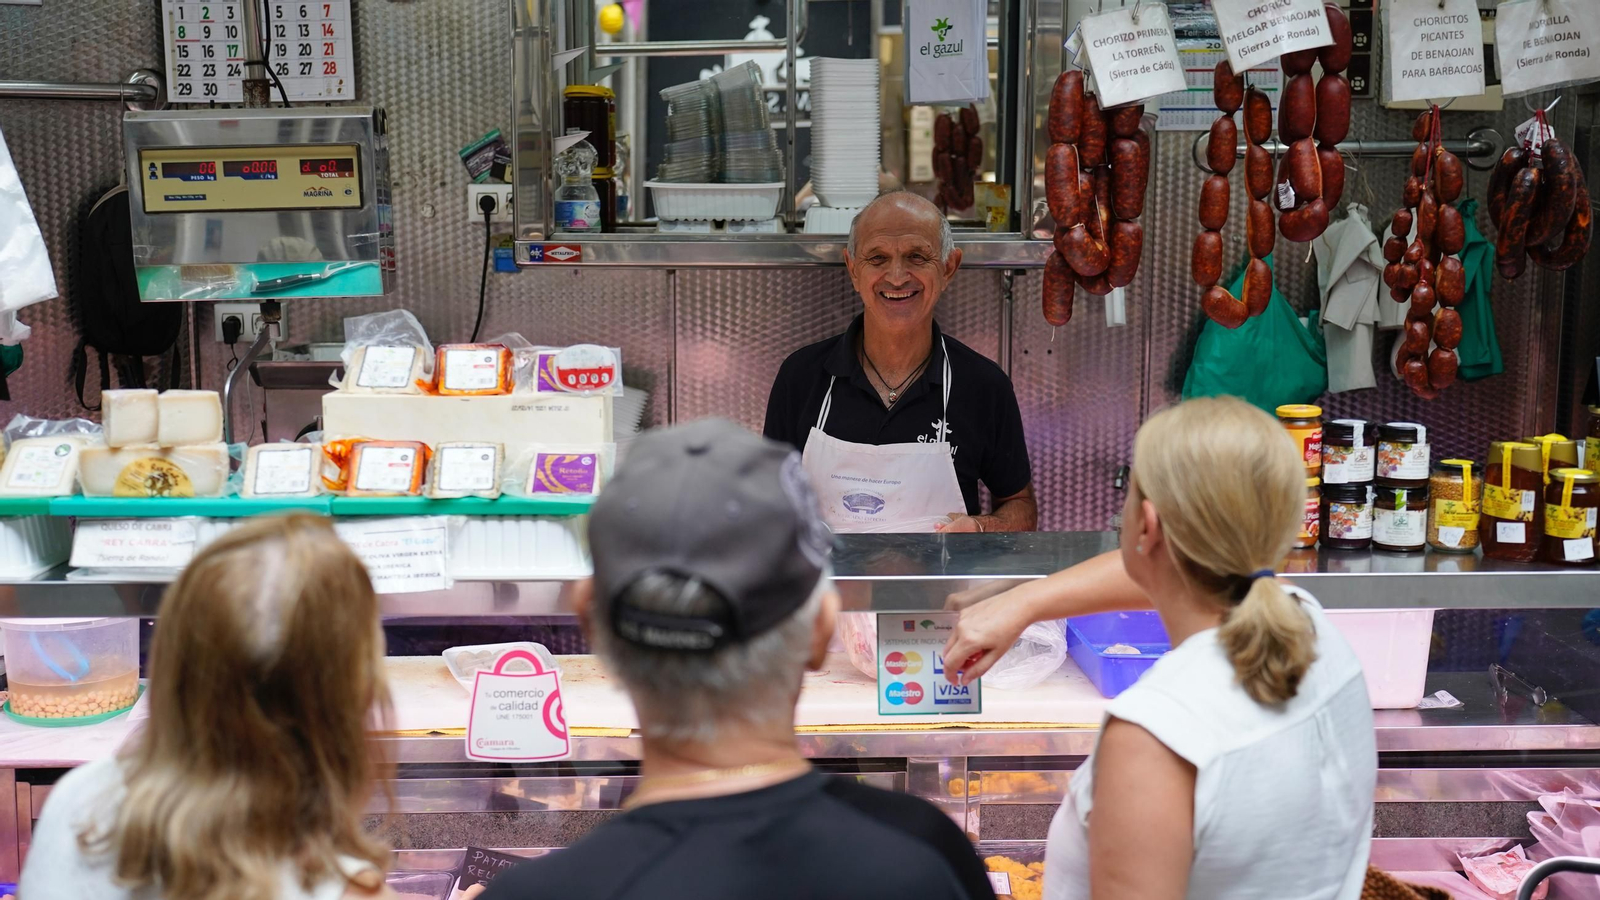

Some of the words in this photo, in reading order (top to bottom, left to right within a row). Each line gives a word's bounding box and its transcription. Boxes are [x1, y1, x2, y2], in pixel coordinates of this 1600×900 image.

[178, 6, 184, 20] 1
[202, 6, 210, 20] 2
[227, 6, 234, 20] 3
[276, 5, 283, 18] 5
[300, 5, 307, 18] 6
[323, 4, 330, 17] 7
[1247, 0, 1291, 19] CHORIZO
[1226, 22, 1268, 45] MELGAR
[1270, 9, 1321, 27] BENAOJAN
[1413, 14, 1469, 27] CHORICITOS
[178, 26, 186, 39] 8
[204, 26, 211, 39] 9
[225, 25, 238, 38] 10
[274, 25, 286, 38] 12
[298, 24, 310, 37] 13
[322, 23, 334, 36] 14
[1420, 30, 1464, 42] PICANTES
[1093, 31, 1135, 48] CHORIZO
[1238, 39, 1270, 59] (Sierra
[1273, 35, 1285, 43] de
[1287, 26, 1320, 40] Ronda)
[1523, 40, 1532, 49] DE
[1534, 31, 1581, 47] BENAOJAN
[177, 45, 189, 58] 15
[202, 44, 214, 58] 16
[226, 44, 238, 57] 17
[275, 44, 287, 57] 19
[298, 43, 312, 56] 20
[323, 42, 334, 55] 21
[920, 42, 930, 55] el
[933, 39, 963, 58] gazul
[1112, 51, 1125, 61] LA
[1126, 43, 1166, 59] TORREÑA
[1411, 51, 1423, 60] DE
[1425, 47, 1474, 59] BENAOJAN
[1516, 56, 1544, 69] (Sierra
[1545, 52, 1553, 62] de
[1555, 47, 1590, 60] Ronda)
[177, 64, 191, 77] 22
[202, 64, 216, 77] 23
[227, 64, 241, 76] 24
[275, 63, 289, 76] 26
[299, 62, 312, 75] 27
[323, 62, 336, 74] 28
[1109, 66, 1139, 81] (Sierra
[1140, 65, 1151, 74] de
[1152, 60, 1175, 71] Cádiz)
[1402, 69, 1426, 79] PARA
[1429, 64, 1483, 77] BARBACOAS
[178, 83, 192, 96] 29
[203, 83, 218, 96] 30
[101, 523, 130, 531] QUESO
[886, 660, 922, 668] MasterCard
[493, 688, 544, 698] comercio
[889, 690, 921, 698] Maestro
[939, 684, 970, 696] VISA
[498, 700, 539, 711] calidad
